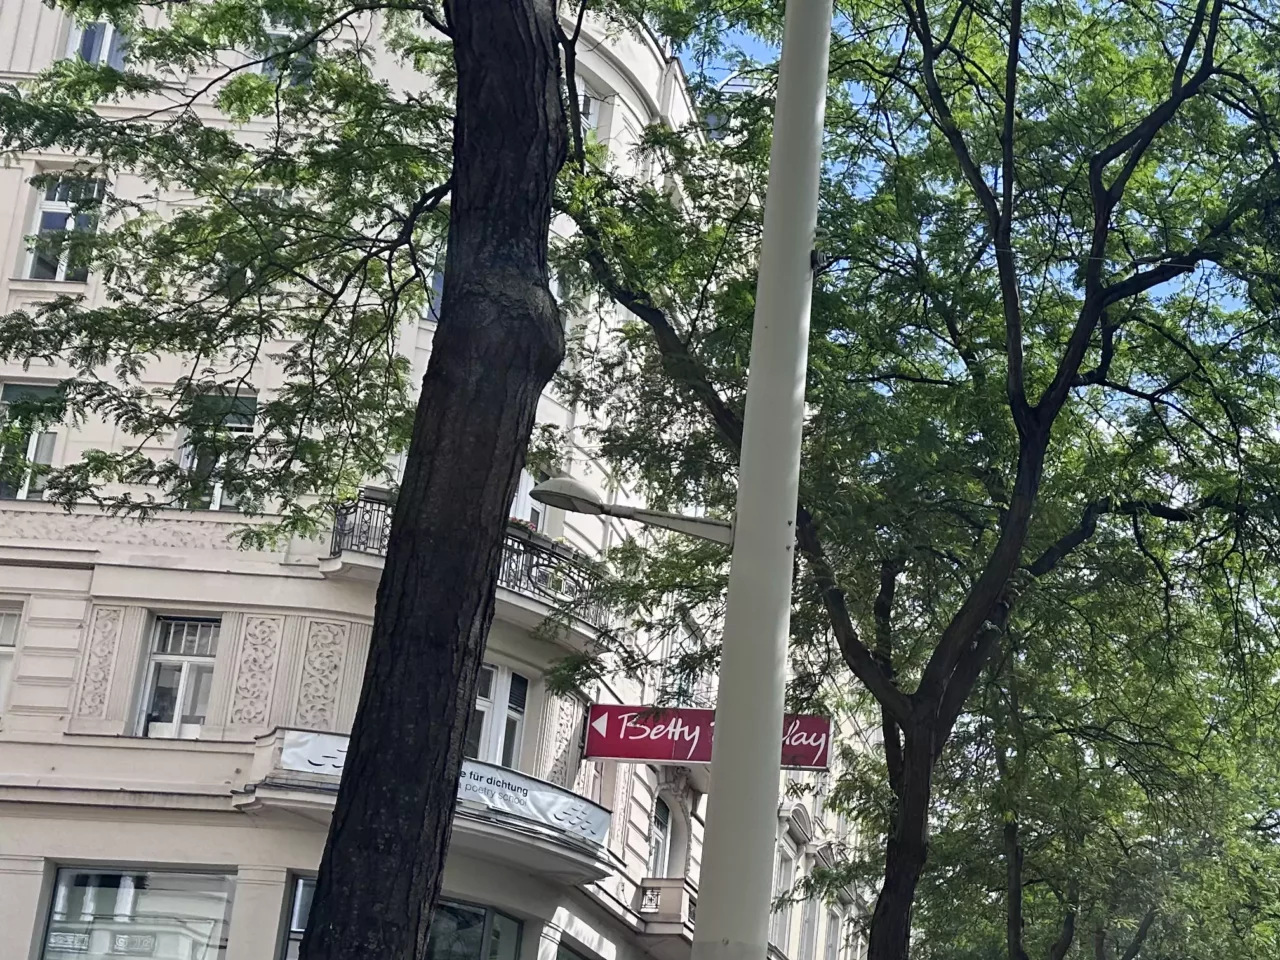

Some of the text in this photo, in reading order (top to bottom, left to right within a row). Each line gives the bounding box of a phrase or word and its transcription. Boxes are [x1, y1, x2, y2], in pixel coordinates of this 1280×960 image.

[617, 711, 700, 760] Betty
[464, 783, 496, 799] poetry
[498, 790, 527, 807] school
[469, 769, 484, 783] für
[486, 776, 529, 797] dichtung
